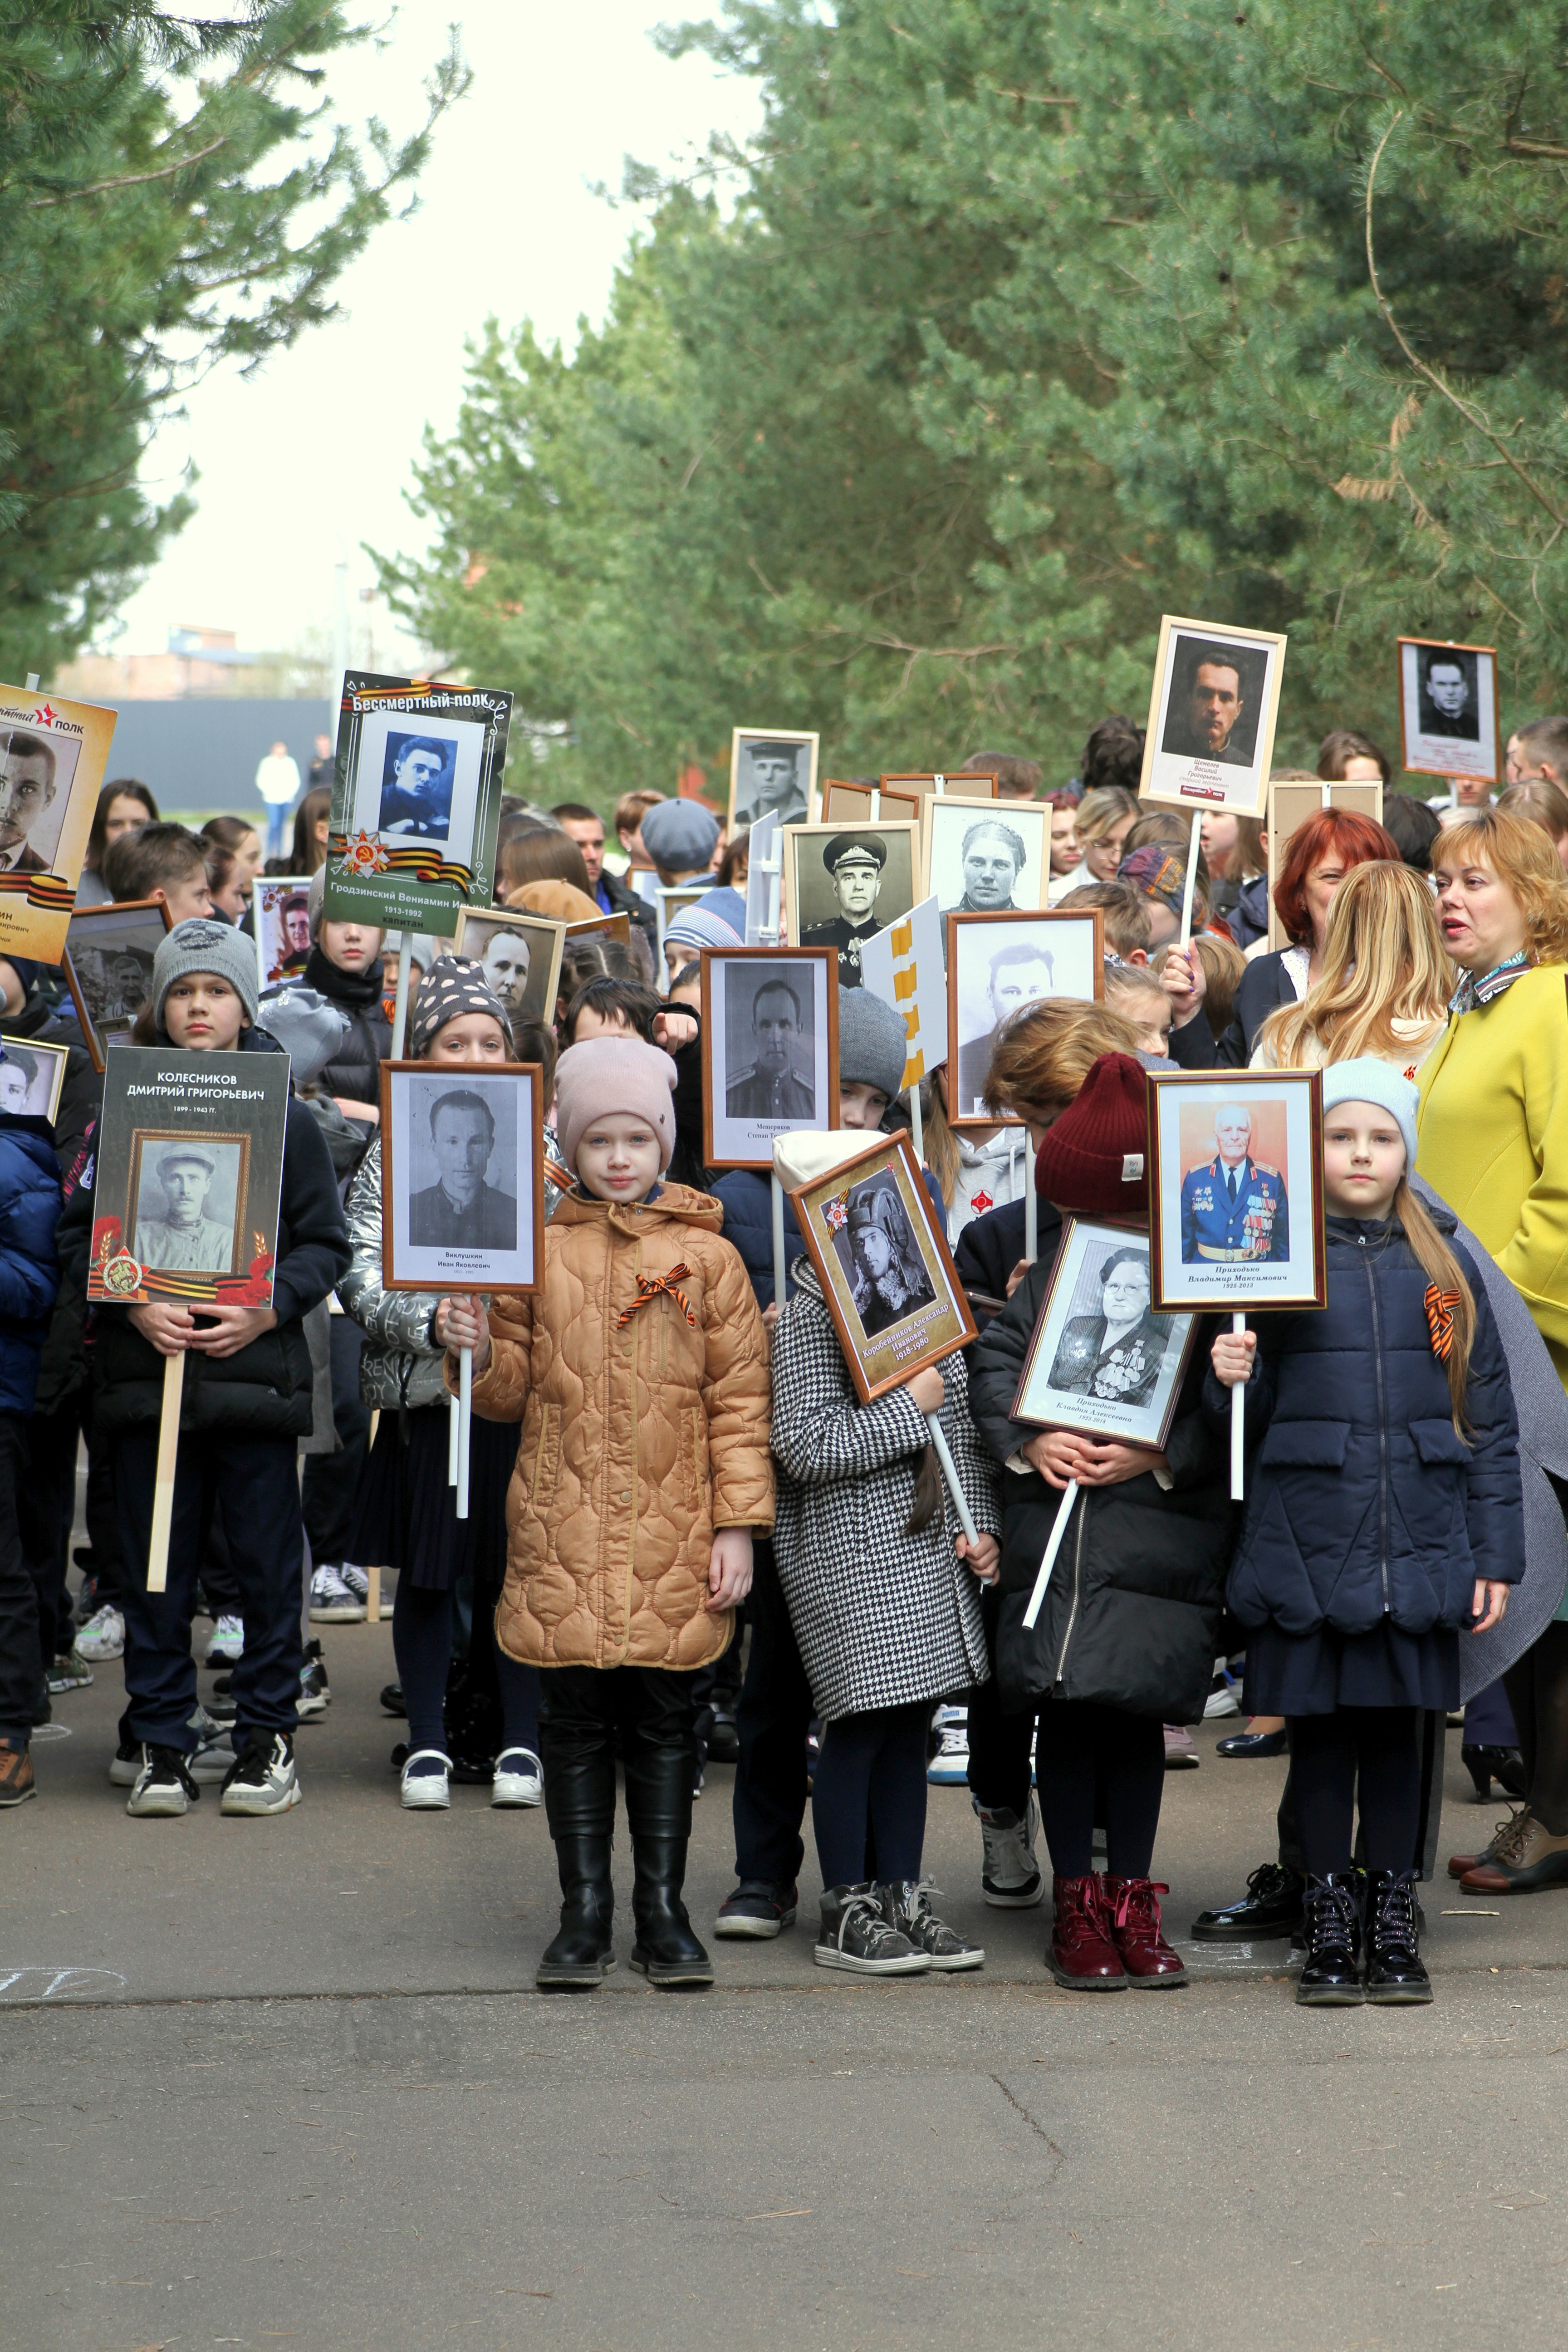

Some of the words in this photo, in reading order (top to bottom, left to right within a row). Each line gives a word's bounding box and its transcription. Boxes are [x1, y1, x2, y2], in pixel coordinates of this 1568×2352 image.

[353, 692, 450, 712] Бессмертный
[454, 694, 489, 707] полк
[1194, 759, 1220, 768] Щемелев
[1194, 765, 1218, 774] Василий
[1188, 771, 1222, 781] Григорьевич
[1201, 780, 1229, 789] лейтенант
[331, 882, 396, 901] Гродзинский
[398, 892, 449, 907] Вениамин
[384, 906, 422, 917] 1913-1992
[382, 916, 423, 928] капитан
[157, 1073, 237, 1085] КОЛЕСНИКОВ
[127, 1085, 185, 1097] ДМИТРИЙ
[187, 1088, 265, 1100] ГРИГОРЬЕВИЧ
[862, 1326, 912, 1358] Коробейников
[913, 1303, 949, 1329] Александр
[891, 1328, 926, 1352] Иванович
[895, 1337, 929, 1361] 1918-1980
[1076, 1397, 1117, 1411] Приходько
[1056, 1402, 1088, 1414] Клавдия
[1089, 1409, 1132, 1422] Алексеевна
[1078, 1415, 1107, 1424] 1923-2018
[942, 1710, 960, 1719] PUMA
